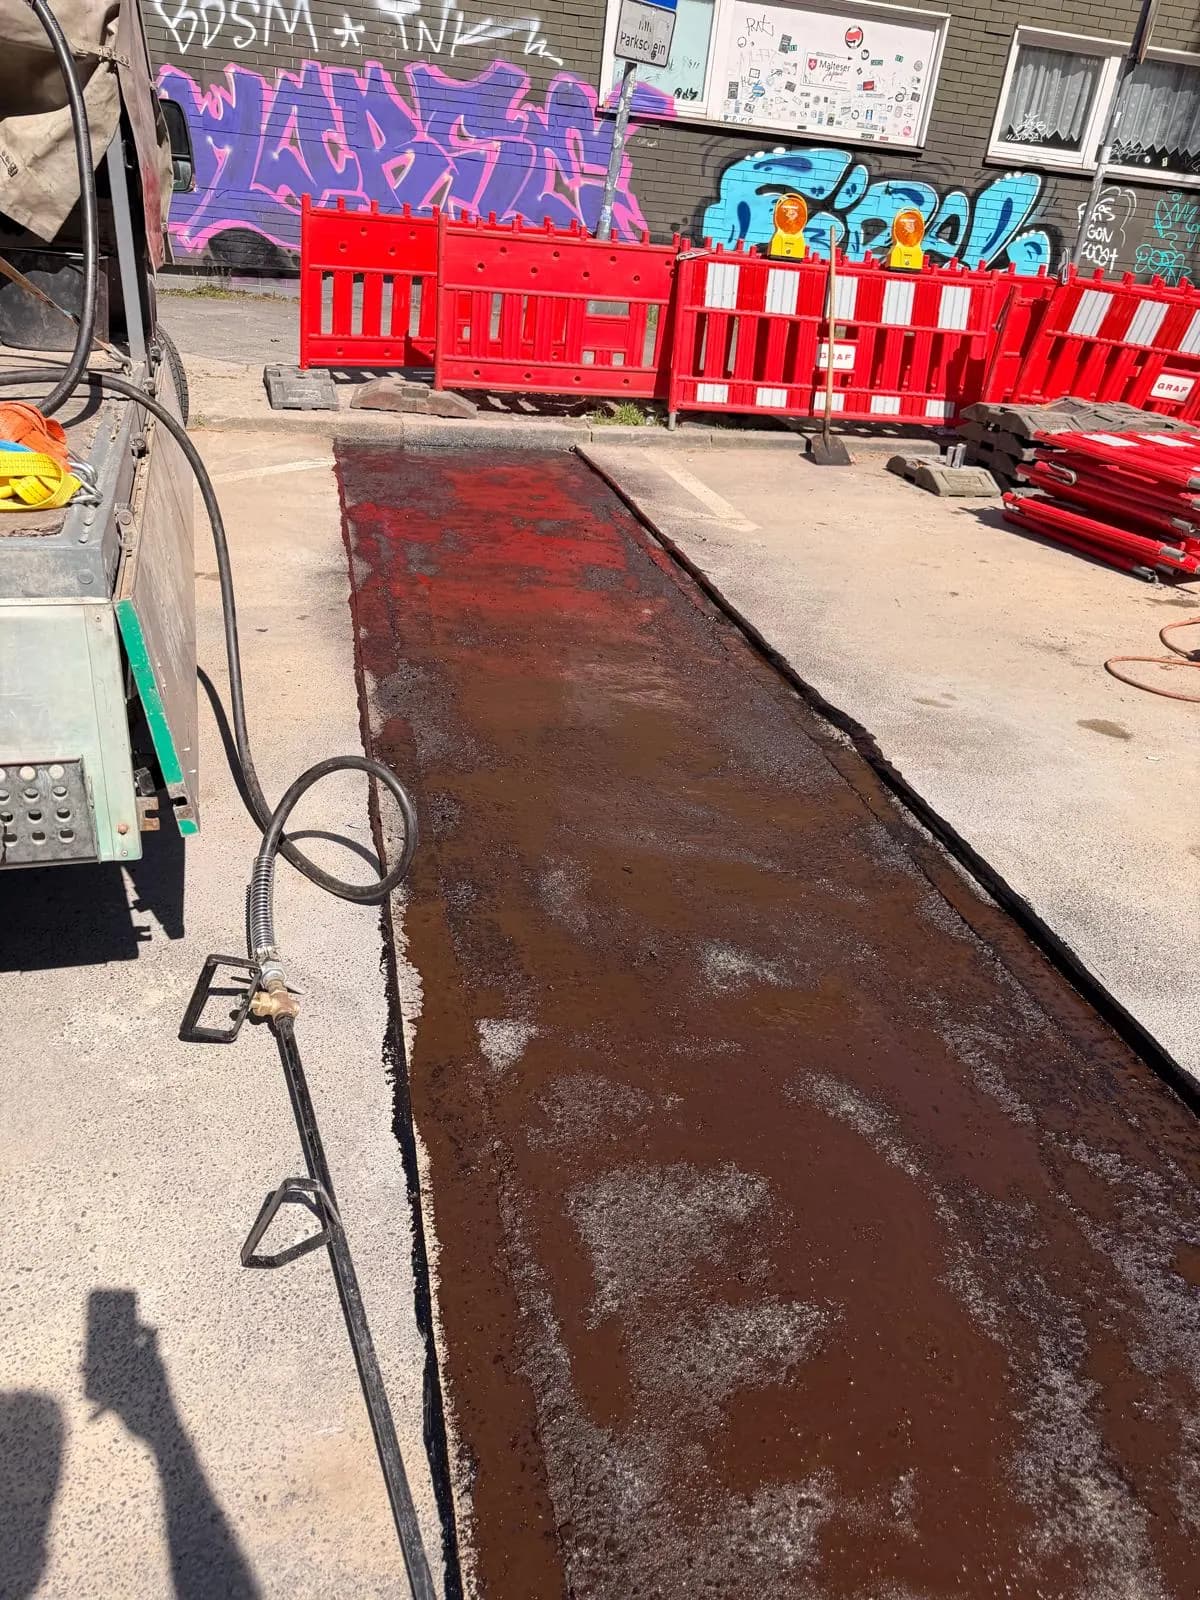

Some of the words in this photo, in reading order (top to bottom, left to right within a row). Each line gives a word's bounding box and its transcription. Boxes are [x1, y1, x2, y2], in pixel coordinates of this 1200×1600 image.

[620, 31, 666, 56] Parkscein
[819, 59, 852, 72] Malteser
[820, 352, 853, 361] GAF
[1157, 382, 1189, 393] GRAF
